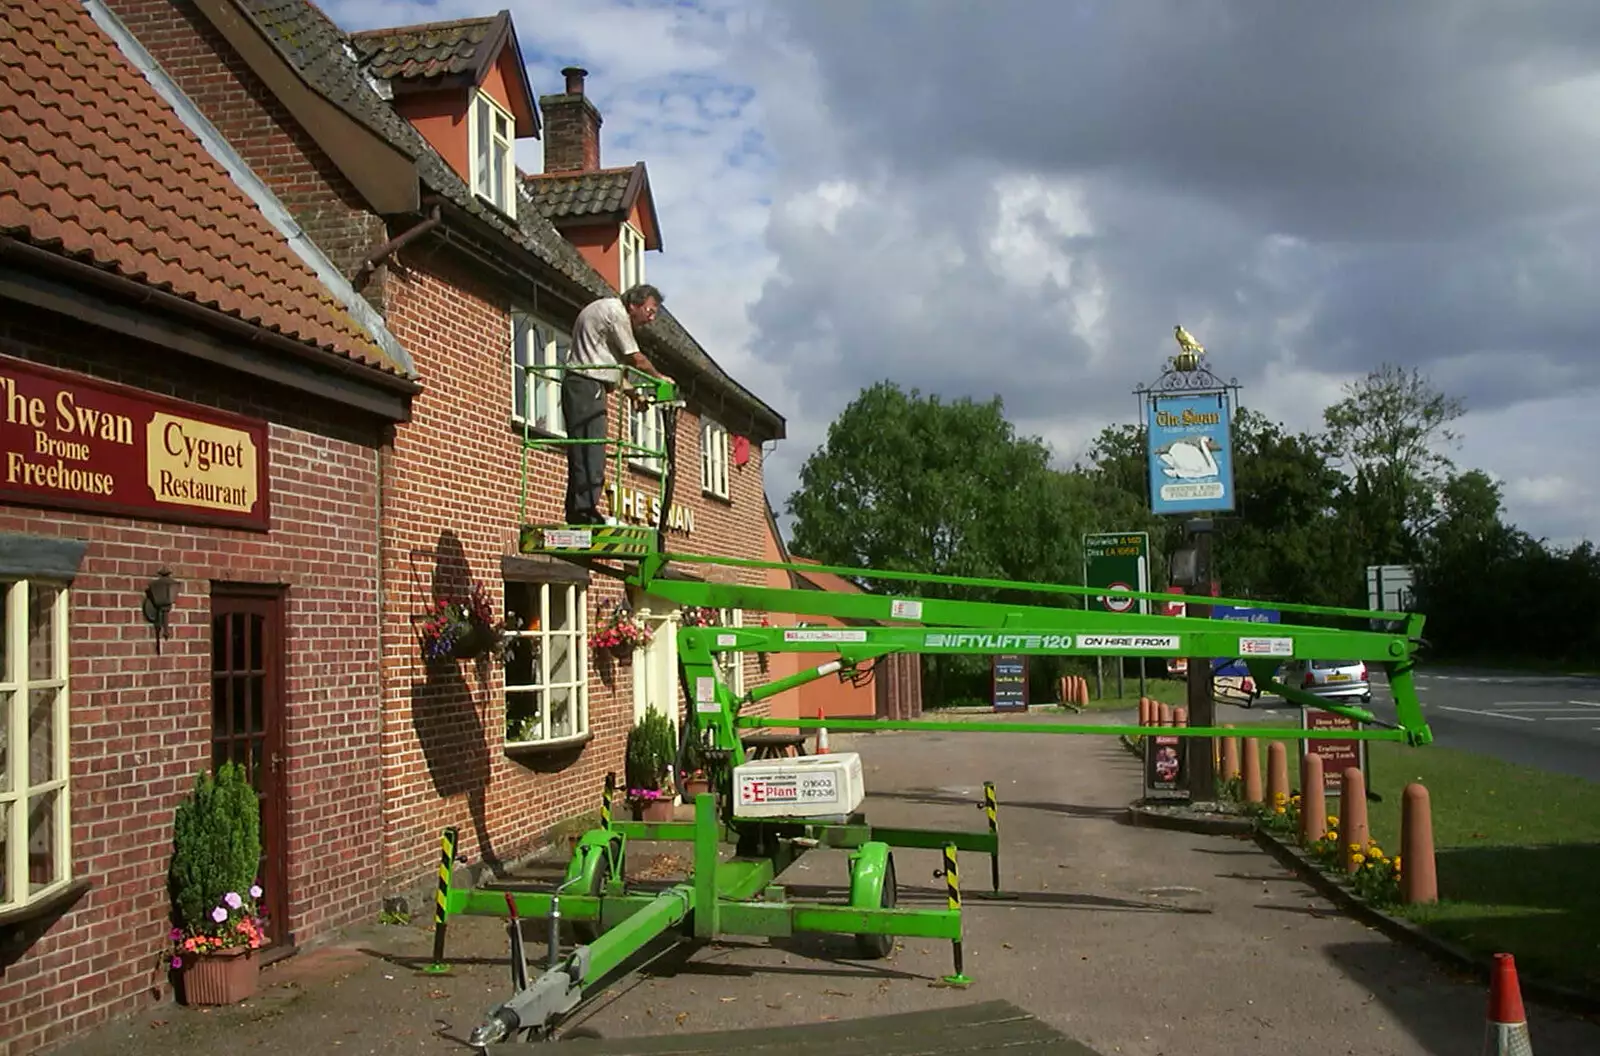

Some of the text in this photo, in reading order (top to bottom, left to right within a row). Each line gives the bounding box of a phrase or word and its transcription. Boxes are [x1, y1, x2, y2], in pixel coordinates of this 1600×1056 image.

[56, 390, 133, 445] Swan
[35, 430, 89, 460] Brome
[163, 422, 243, 472] Cygnet
[6, 452, 113, 495] Freehouse
[160, 470, 247, 506] Restaurant
[940, 634, 1171, 649] NIFTYLIFT 120 ON HIRE FROM
[766, 787, 797, 797] Plant
